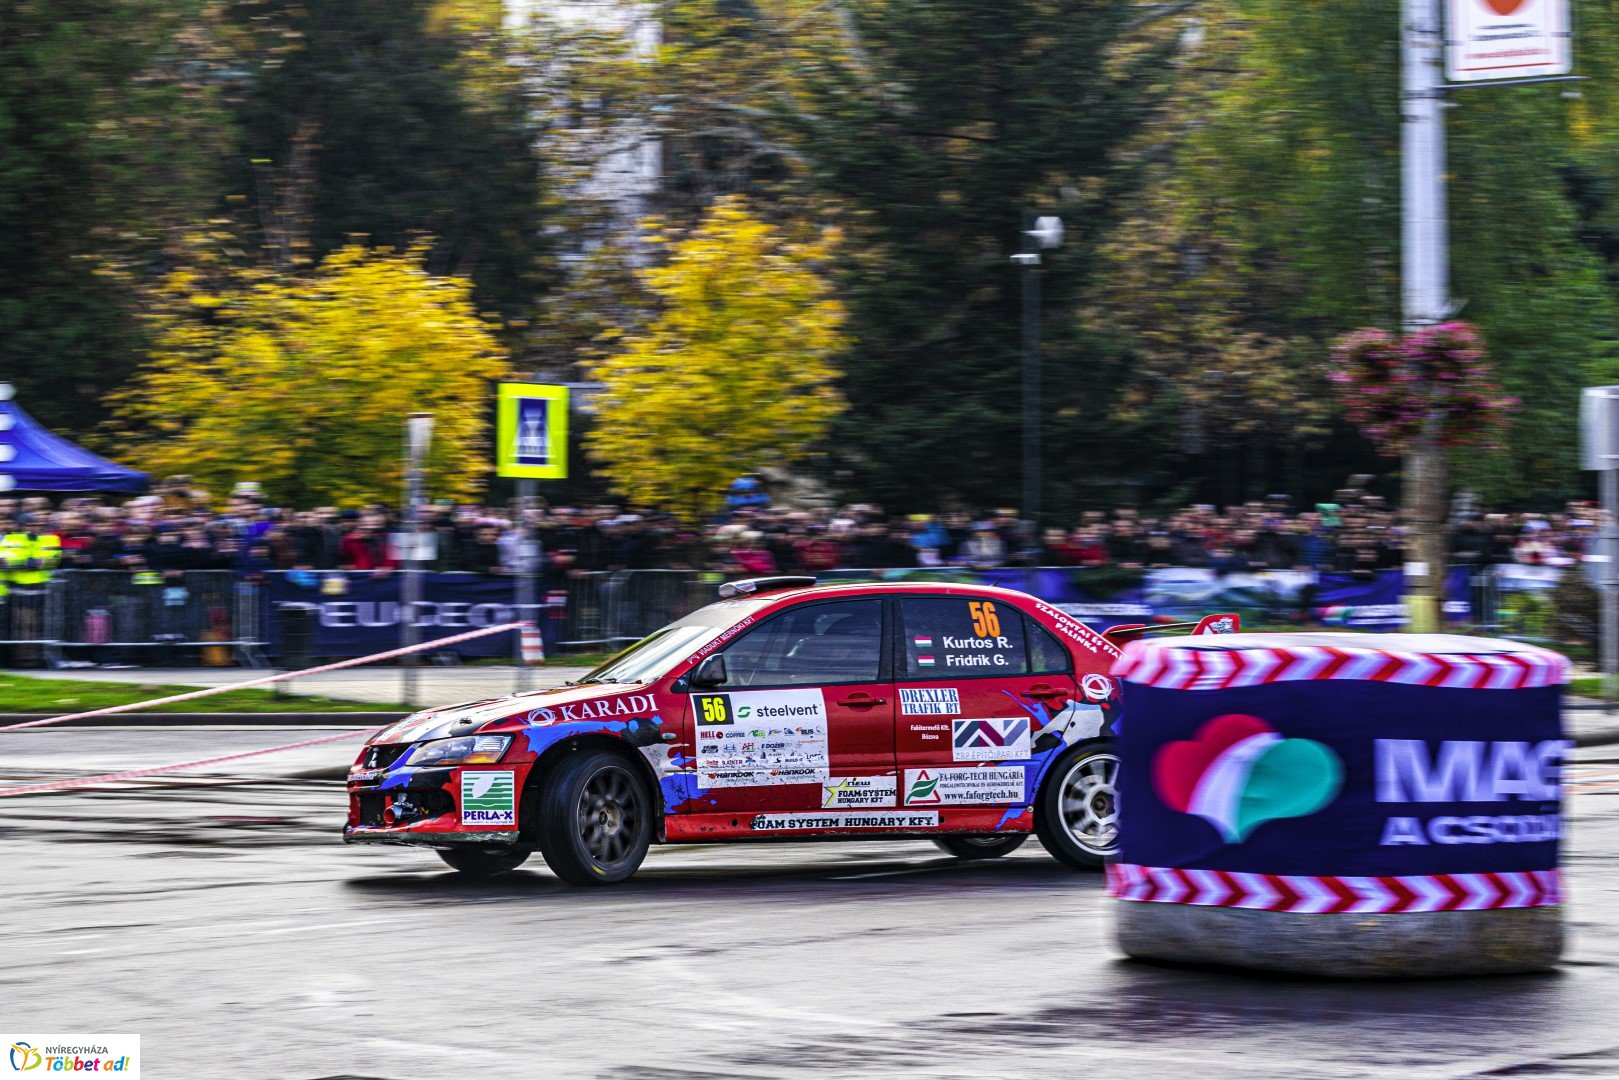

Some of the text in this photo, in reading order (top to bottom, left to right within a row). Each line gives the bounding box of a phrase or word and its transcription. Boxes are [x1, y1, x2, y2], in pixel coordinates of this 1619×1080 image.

[969, 601, 1001, 637] 56
[1035, 603, 1091, 639] SZALONTAI
[943, 636, 1013, 649] Kurtos R.
[1055, 622, 1098, 654] PÁLINKA
[946, 655, 1009, 667] Fridrik G.
[900, 689, 958, 703] DREXLER
[560, 693, 659, 722] KARADI
[702, 697, 726, 722] 56
[757, 704, 818, 717] steelvent
[902, 702, 959, 714] TRAFIK BT
[700, 731, 715, 739] HELL
[944, 789, 1019, 801] www.faforgtech.hu
[464, 811, 513, 820] PERLA-X
[788, 818, 839, 828] SYSTEM
[845, 817, 905, 827] HUNGARY
[1379, 816, 1430, 846] A
